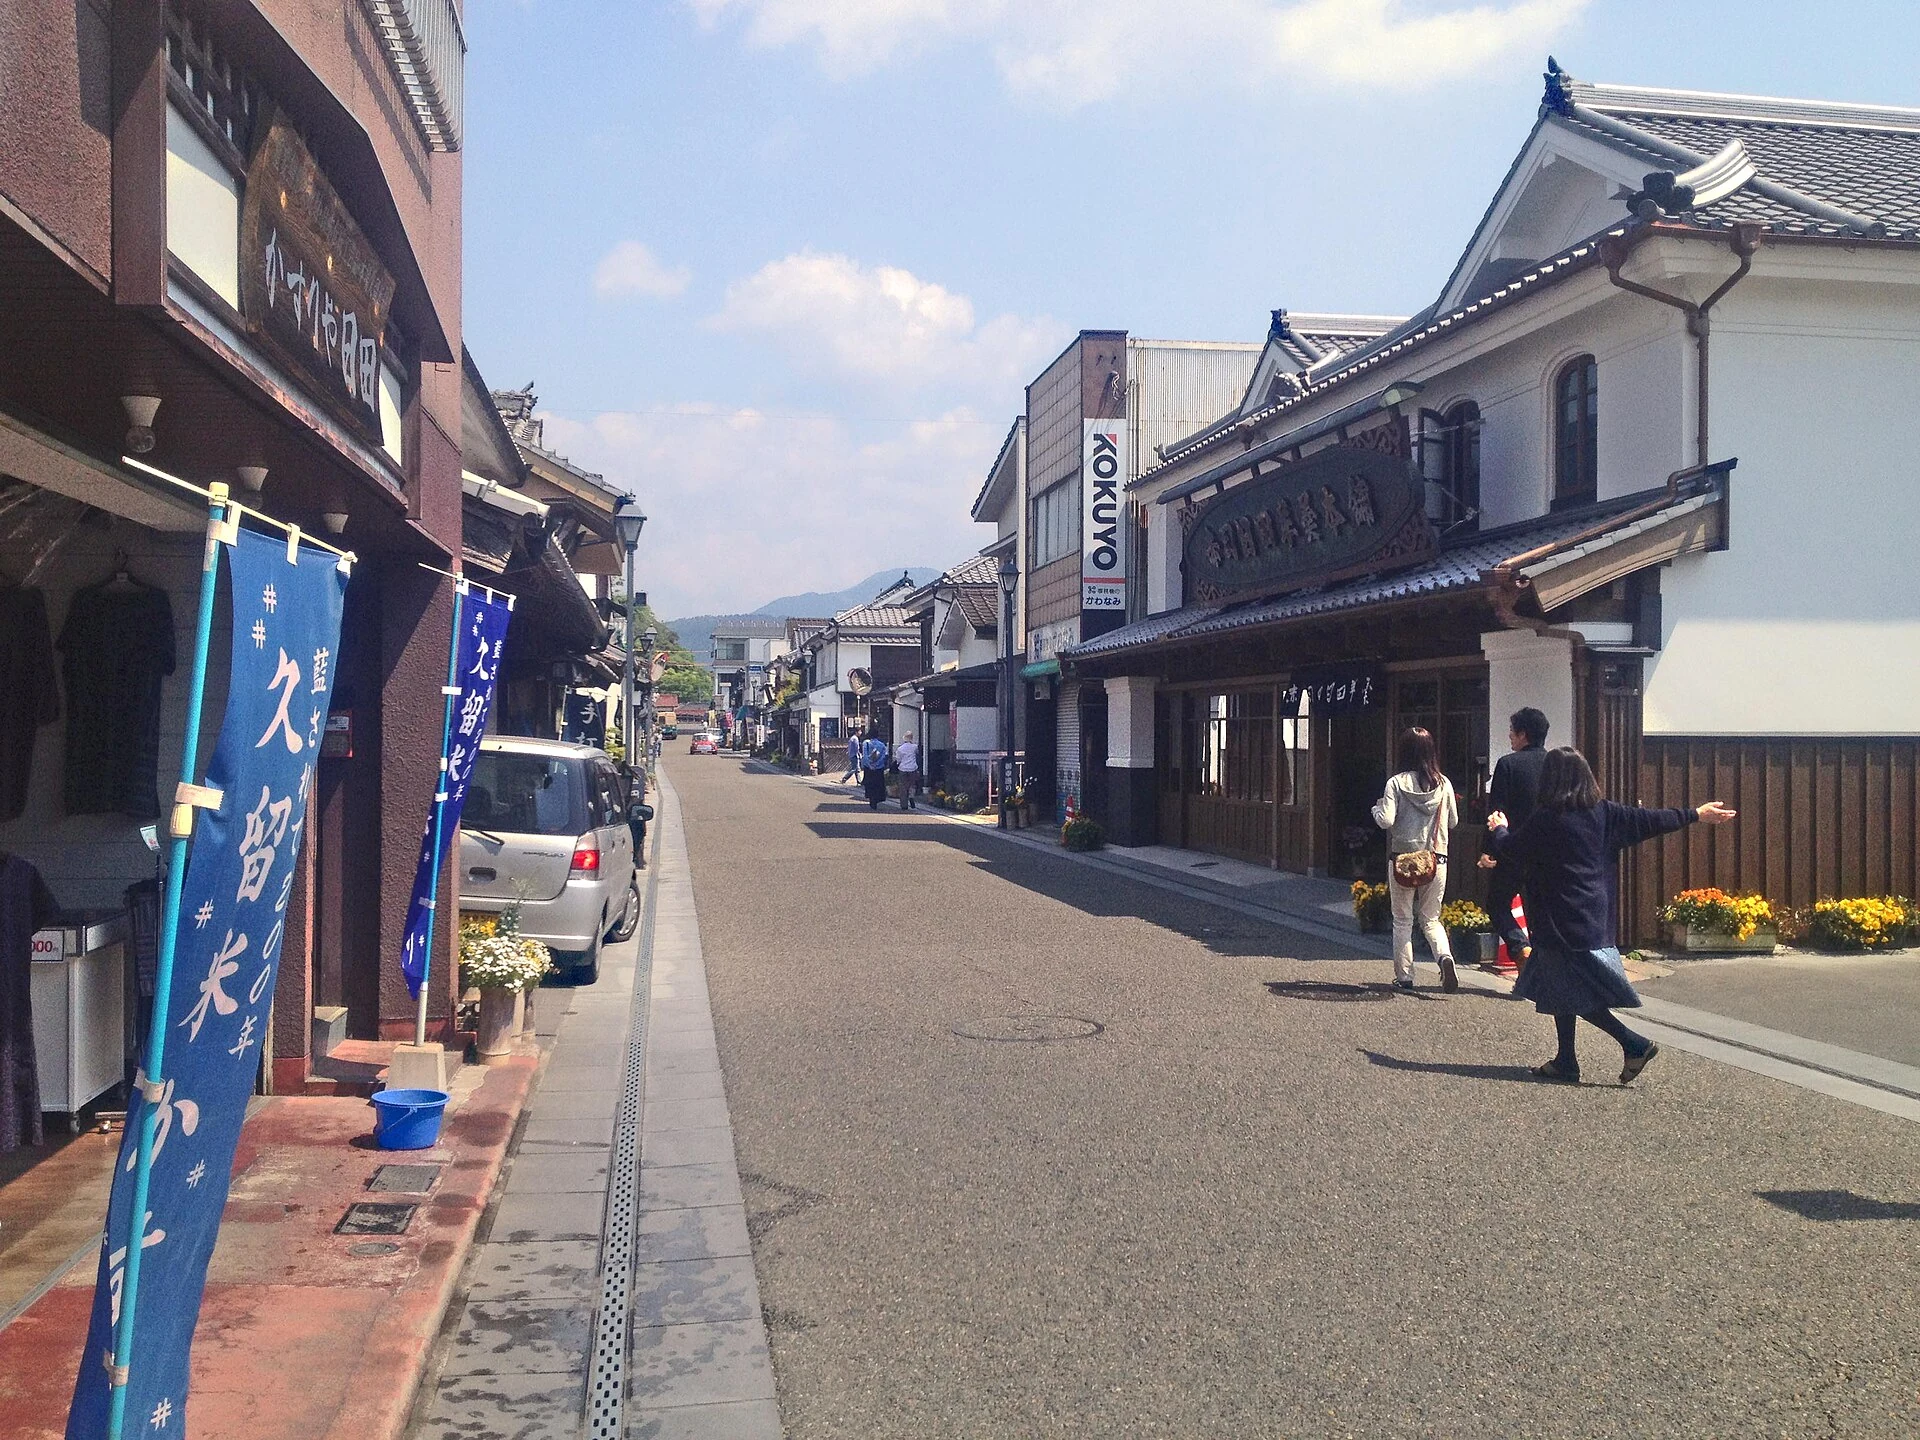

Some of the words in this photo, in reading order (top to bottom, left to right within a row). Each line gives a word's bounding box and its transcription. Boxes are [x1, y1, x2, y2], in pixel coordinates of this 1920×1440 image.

[1091, 433, 1117, 572] KOKUYO
[1085, 597, 1121, 606] かわなみ
